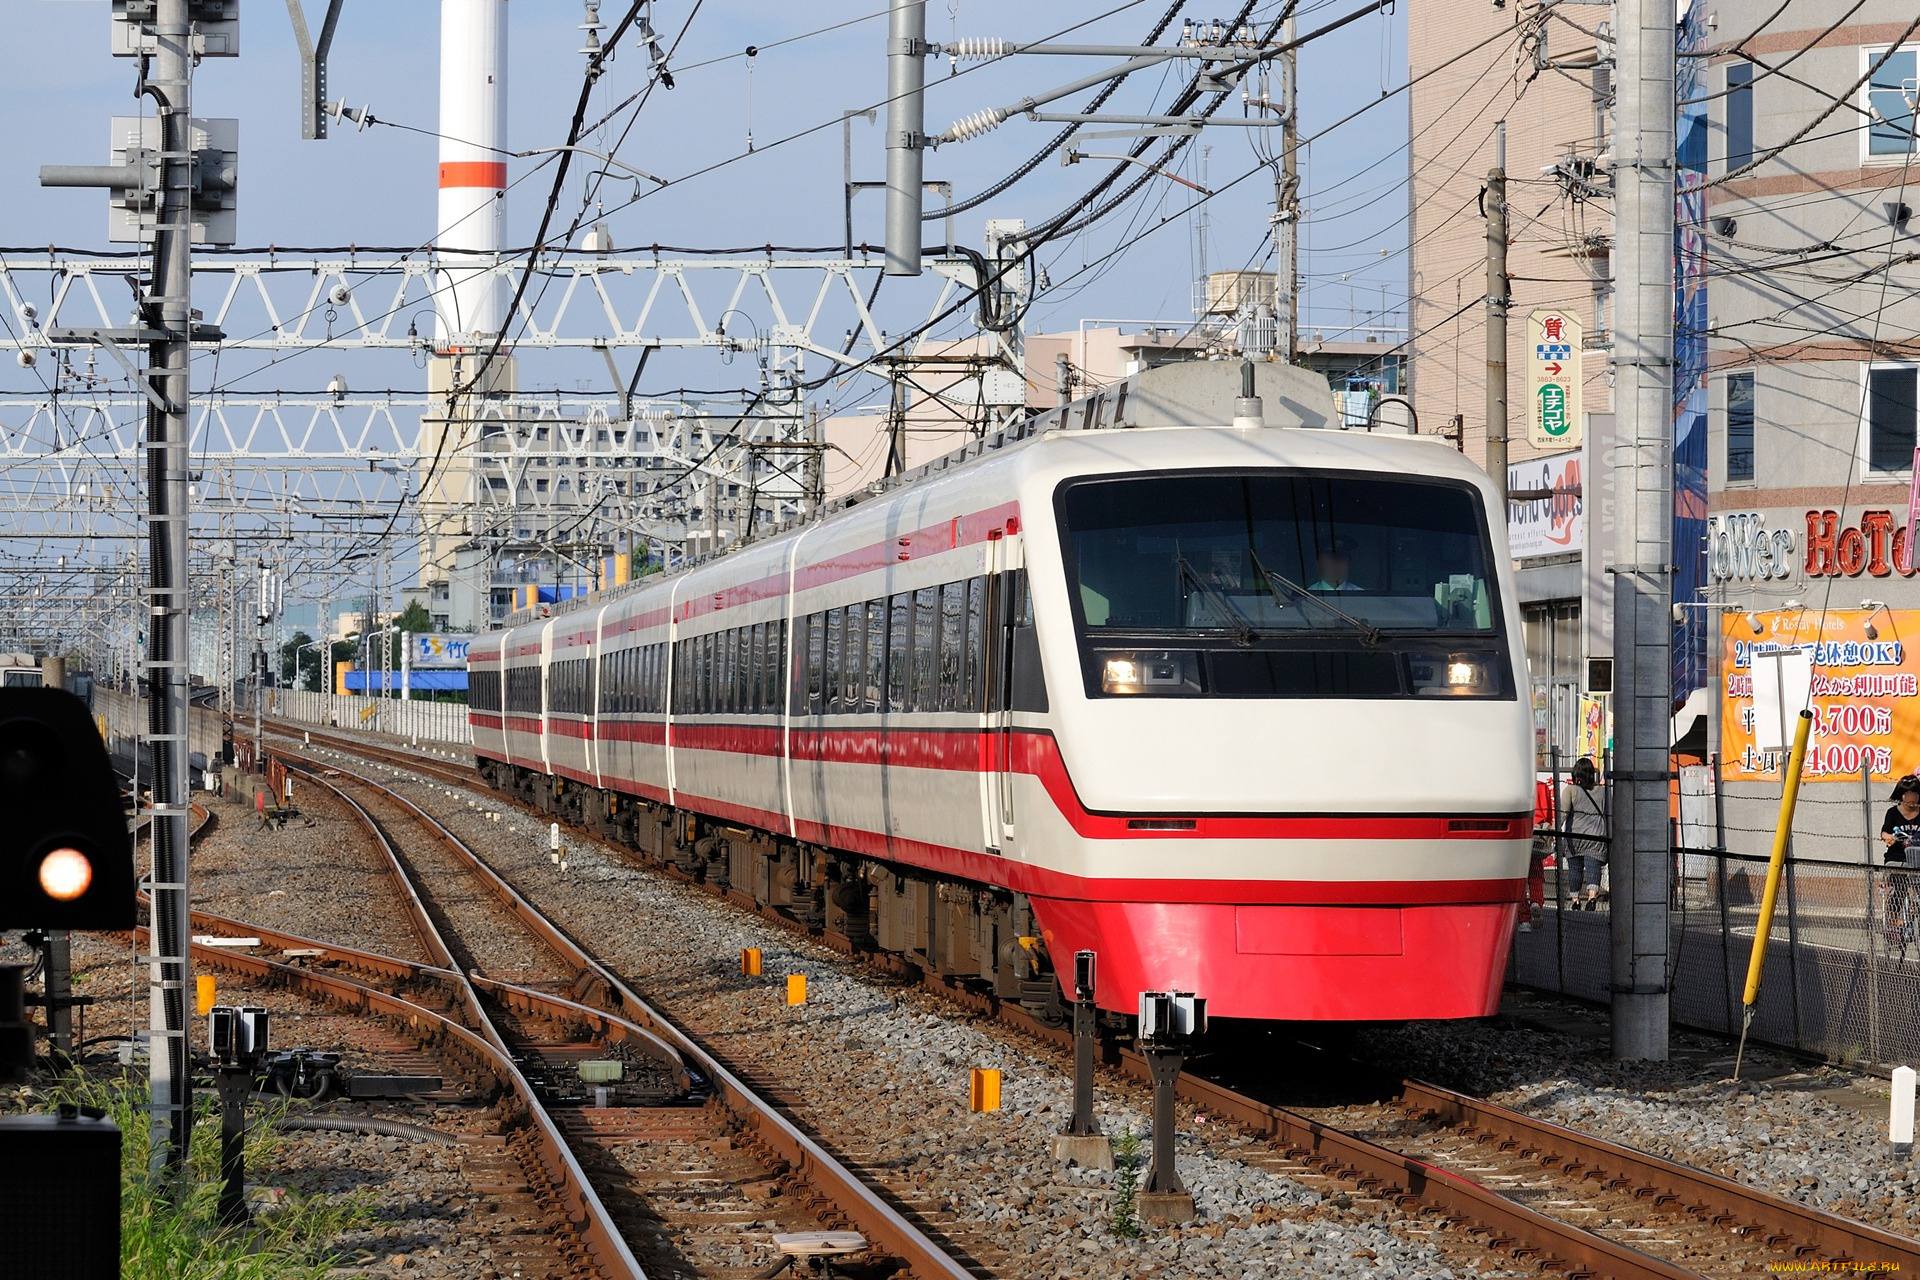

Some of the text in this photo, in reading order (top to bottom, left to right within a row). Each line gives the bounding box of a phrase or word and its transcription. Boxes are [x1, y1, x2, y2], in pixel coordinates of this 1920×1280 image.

[1545, 318, 1563, 341] 質
[1545, 388, 1563, 431] エチゴヤ
